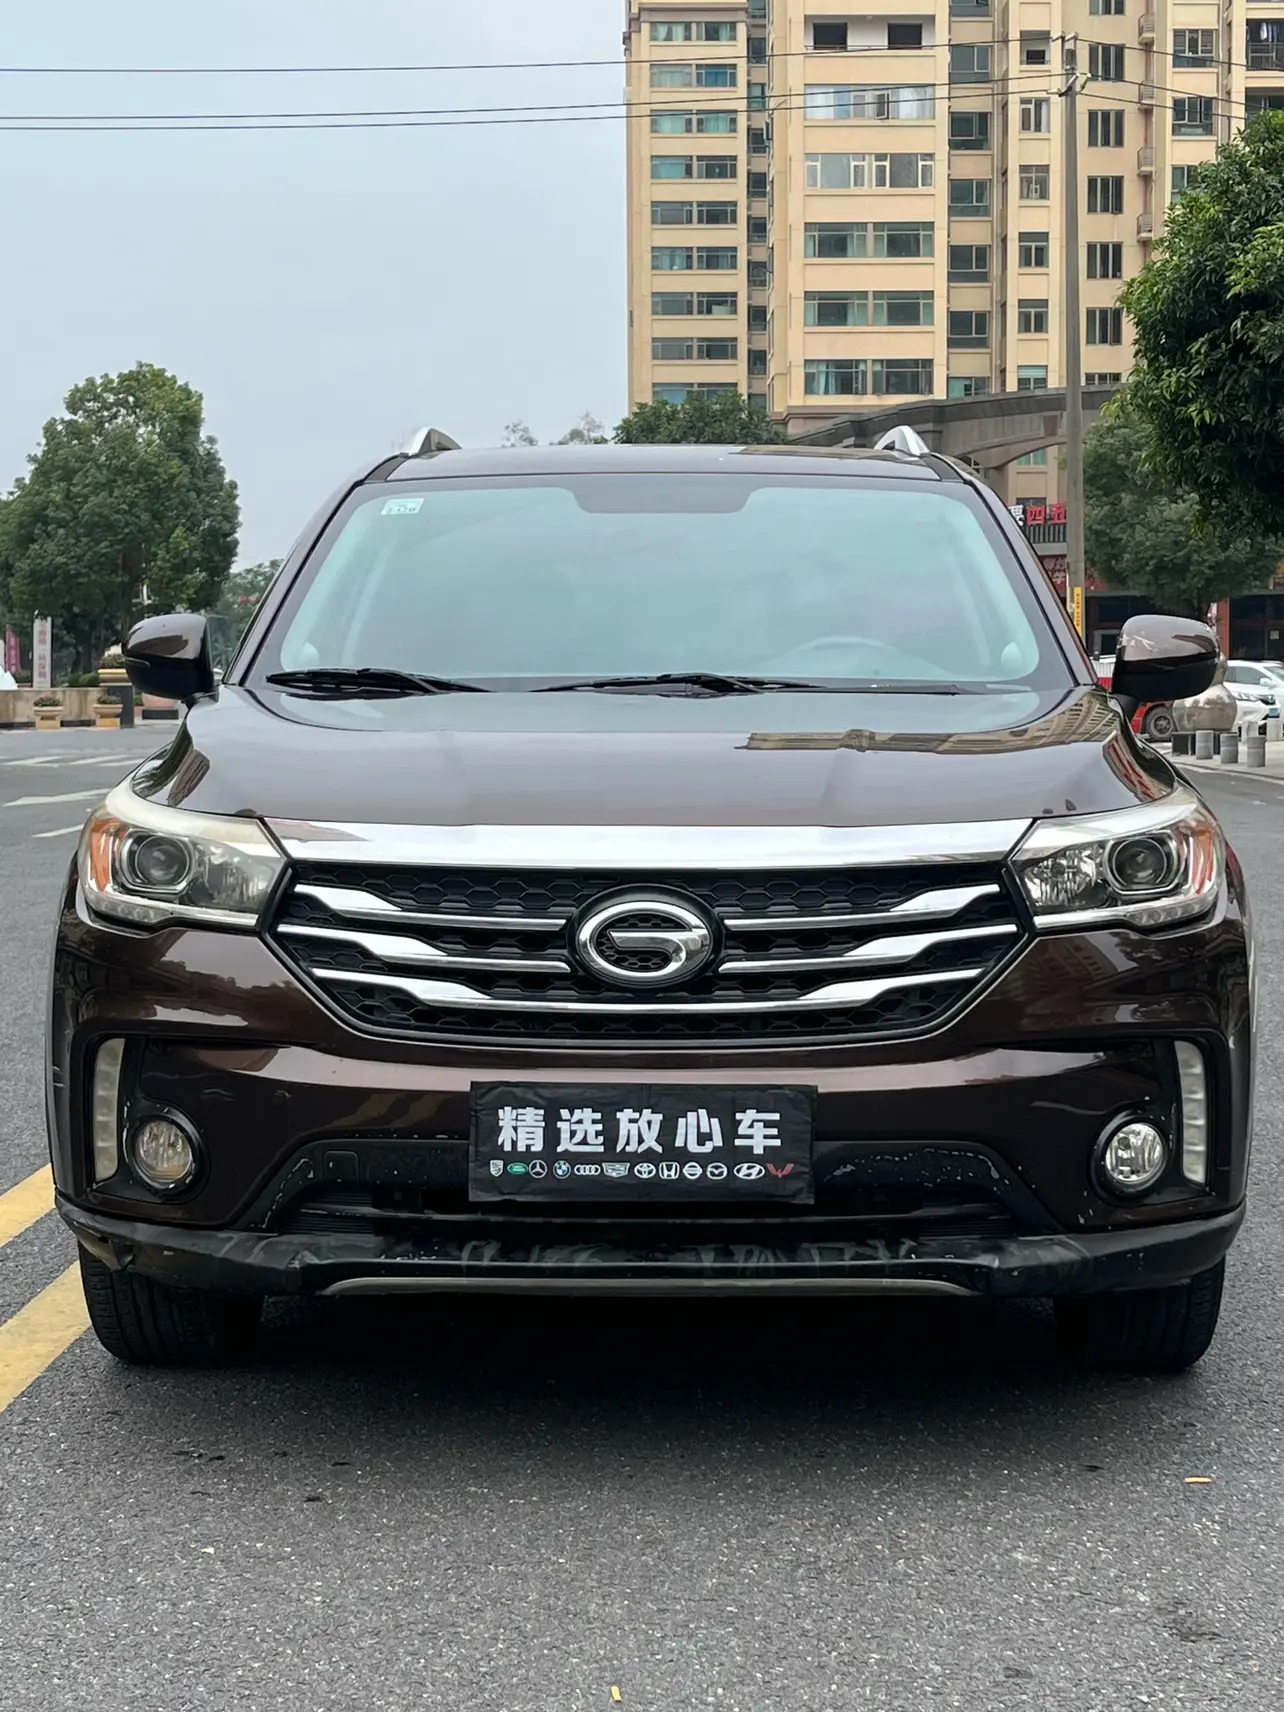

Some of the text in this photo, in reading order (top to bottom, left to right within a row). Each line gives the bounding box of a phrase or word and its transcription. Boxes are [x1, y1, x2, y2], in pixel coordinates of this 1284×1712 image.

[497, 1106, 782, 1154] 精选放心车
